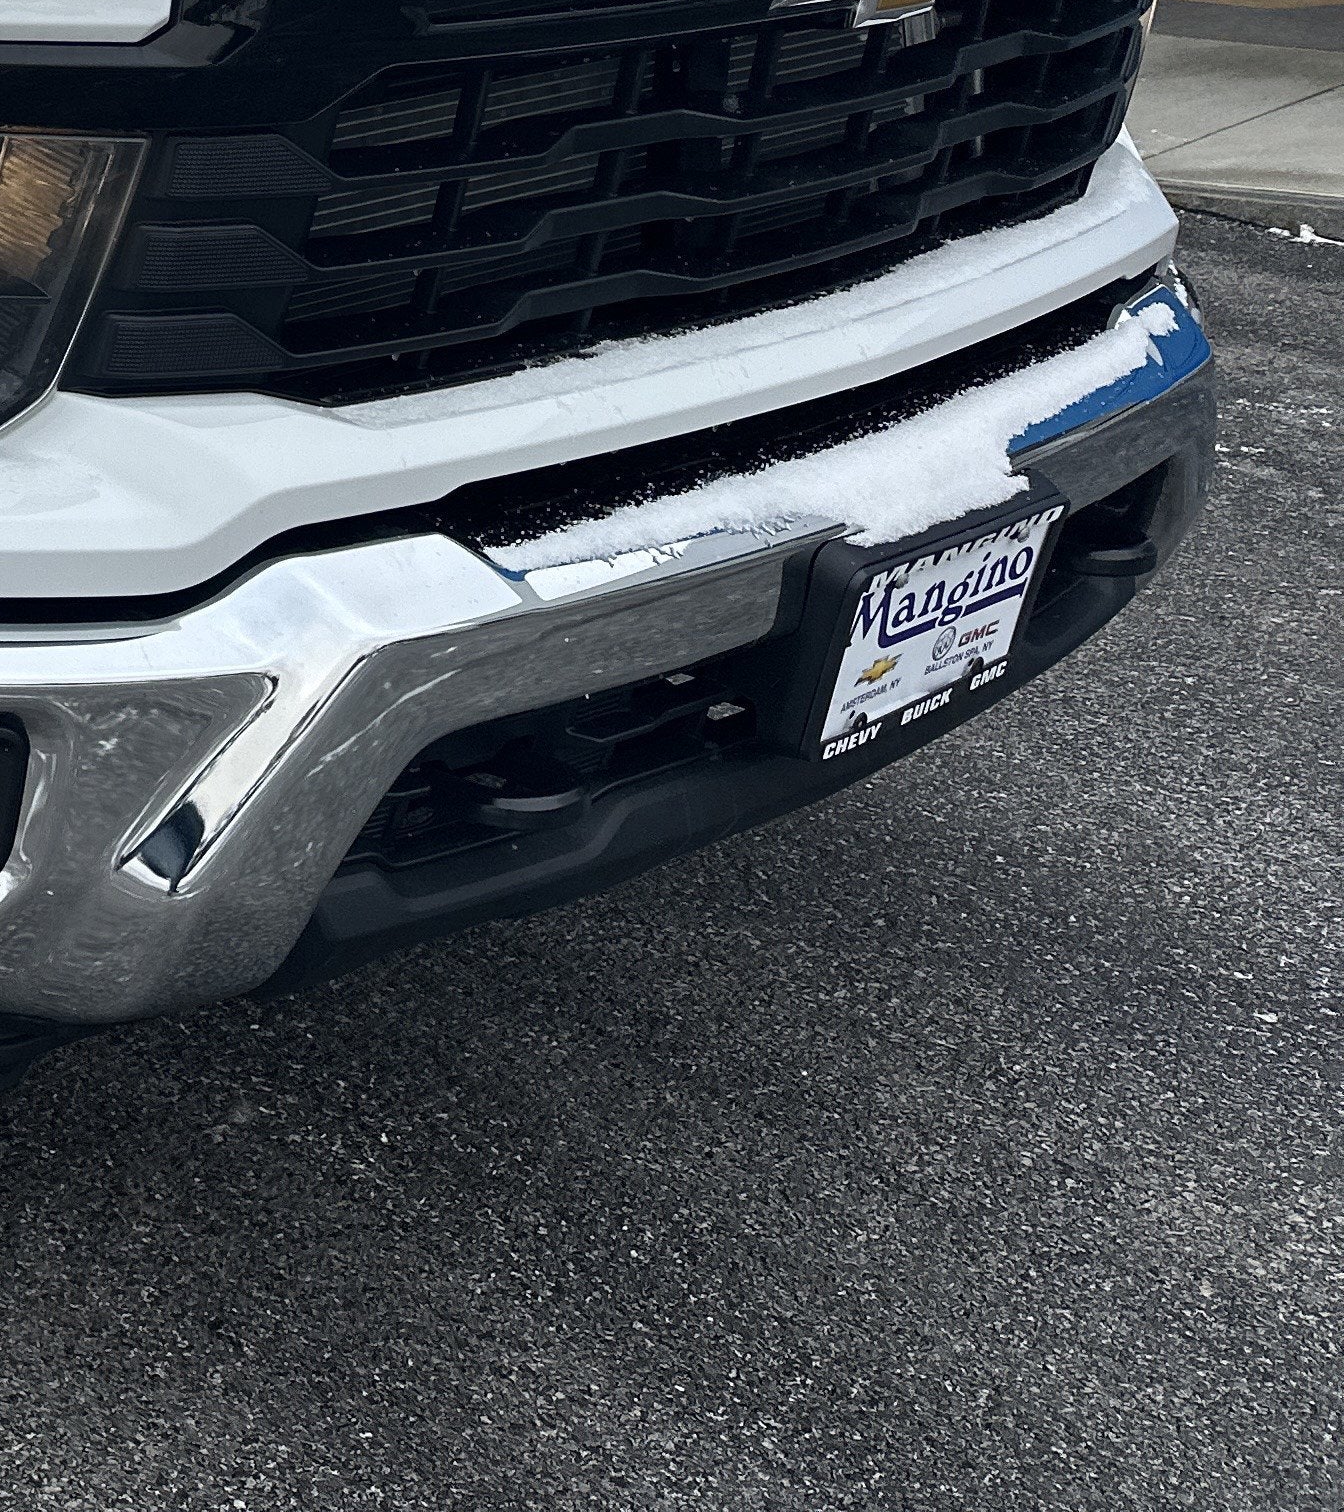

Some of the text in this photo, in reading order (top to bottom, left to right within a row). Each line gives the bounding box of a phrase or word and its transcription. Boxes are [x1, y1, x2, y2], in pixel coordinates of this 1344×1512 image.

[849, 545, 1035, 649] Mangino
[957, 620, 1000, 648] GMC
[822, 660, 1009, 760] CHEVY BUICK GMC
